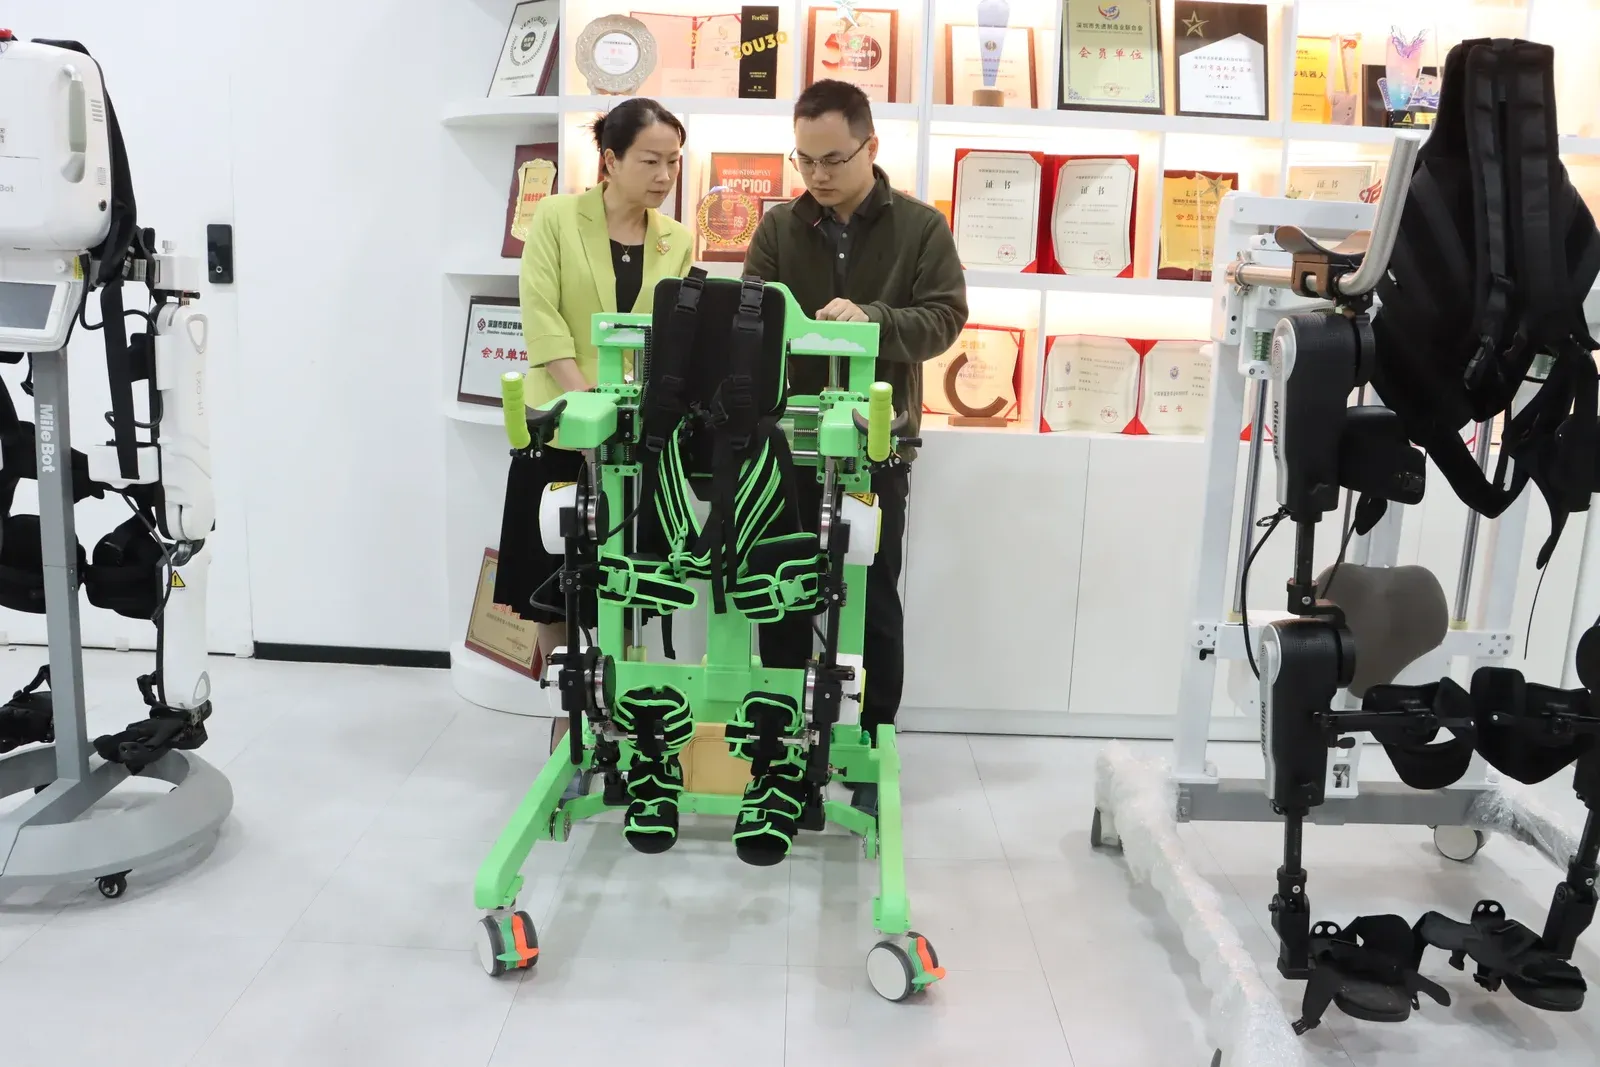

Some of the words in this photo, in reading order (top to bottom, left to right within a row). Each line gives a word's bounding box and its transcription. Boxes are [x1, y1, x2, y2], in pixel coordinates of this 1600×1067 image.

[731, 31, 788, 60] 30U30
[1078, 46, 1143, 61] 会员单位
[481, 347, 528, 361] 会员单位
